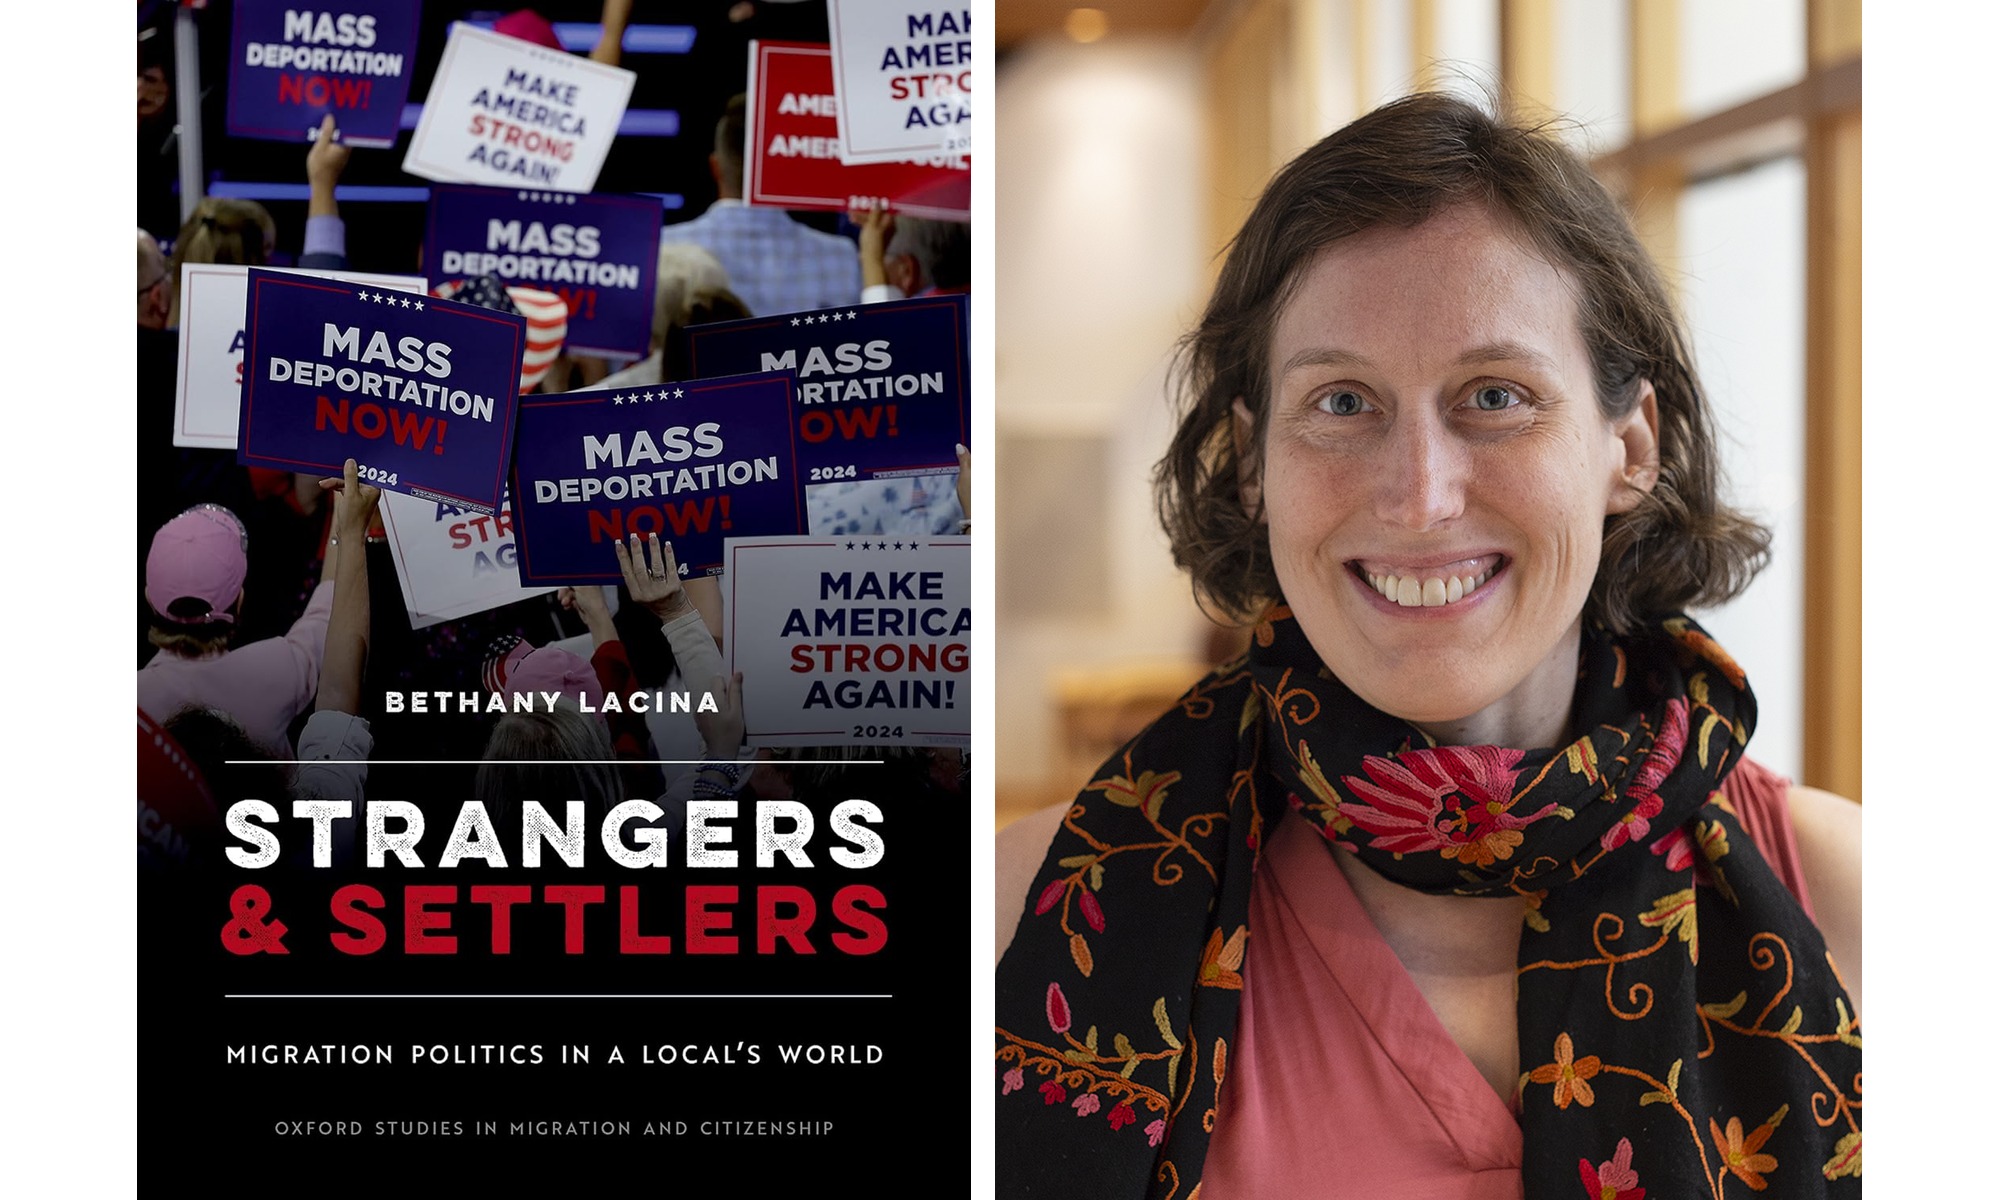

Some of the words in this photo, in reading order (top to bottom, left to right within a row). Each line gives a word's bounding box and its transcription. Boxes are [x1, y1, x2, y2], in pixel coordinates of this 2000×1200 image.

[284, 9, 377, 48] MASS
[245, 42, 403, 77] DEPORTATION
[278, 73, 372, 111] NOW!
[504, 67, 579, 107] MAKE
[471, 88, 587, 138] AMERICA
[468, 114, 575, 164] STRONG
[486, 218, 602, 258] MASS
[441, 250, 640, 290] DEPORTATION
[323, 322, 452, 379] MASS
[761, 340, 893, 377] MASS
[269, 357, 495, 423] DEPORTATION
[315, 395, 448, 456] NOW!
[800, 404, 899, 443] OW!
[582, 422, 724, 470] MASS
[357, 464, 398, 487] 2024
[534, 456, 779, 504] DEPORTATION
[809, 465, 857, 480] 2024
[588, 495, 733, 544] NOW!
[820, 571, 943, 600] MAKE
[780, 607, 972, 638] AMERICA
[789, 643, 970, 674] STRONG
[385, 690, 563, 714] BETHANY
[578, 690, 720, 714] LACINA
[802, 679, 955, 710] AGAIN!
[852, 725, 904, 738] 2024
[226, 799, 885, 869] STRANGERS
[221, 884, 290, 956] &
[331, 884, 889, 956] SETTLERS
[227, 1044, 392, 1065] MIGRATION
[412, 1044, 544, 1065] POLITICS
[562, 1044, 589, 1065] IN
[608, 1045, 625, 1064] A
[643, 1041, 761, 1065] LOCAL'S
[778, 1044, 883, 1065] WORLD
[274, 1121, 363, 1136] OXFORD
[375, 1121, 463, 1136] STUDIES
[476, 1121, 496, 1136] IN
[510, 1121, 631, 1136] MIGRATION
[643, 1121, 688, 1136] AND
[700, 1121, 834, 1136] CITIZENSHIP
